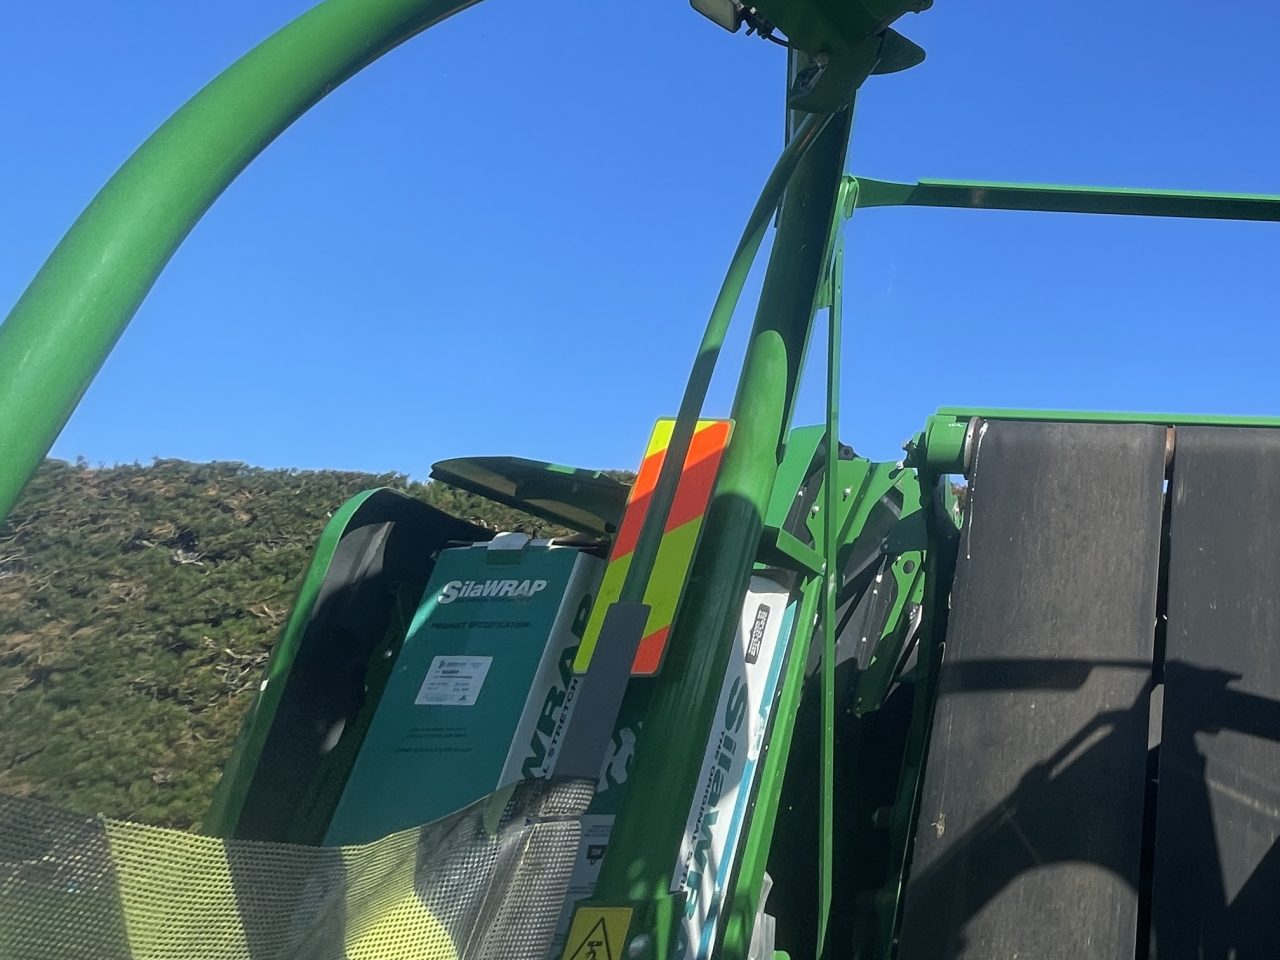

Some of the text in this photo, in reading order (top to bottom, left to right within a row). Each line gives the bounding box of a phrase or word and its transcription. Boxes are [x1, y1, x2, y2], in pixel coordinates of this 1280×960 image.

[438, 579, 548, 604] SilaWRAP
[521, 593, 594, 779] WRAP
[547, 678, 579, 758] STRETCH
[714, 730, 725, 760] THE
[691, 765, 716, 844] ORIGINAL
